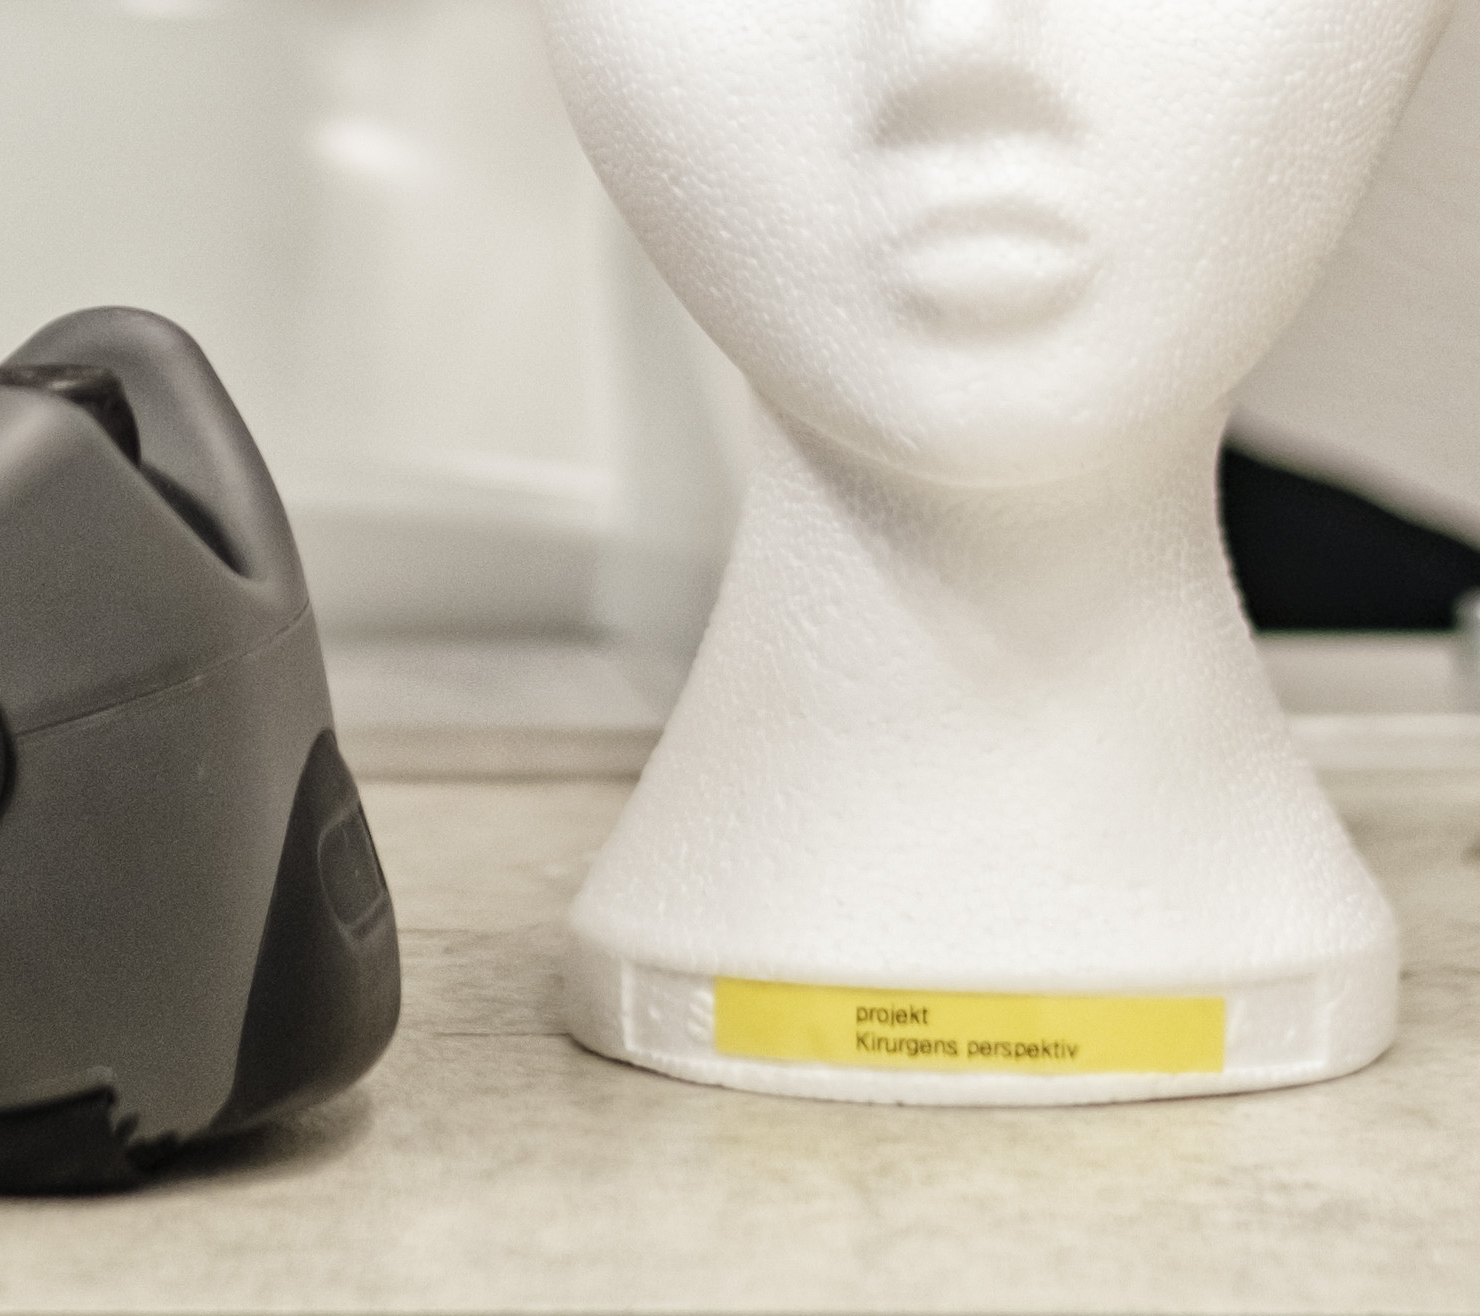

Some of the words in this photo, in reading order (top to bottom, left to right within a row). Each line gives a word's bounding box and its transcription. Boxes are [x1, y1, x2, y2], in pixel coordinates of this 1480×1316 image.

[855, 1003, 929, 1026] projekt
[855, 1031, 959, 1059] Kirurgens
[966, 1037, 1080, 1061] perspektiv
